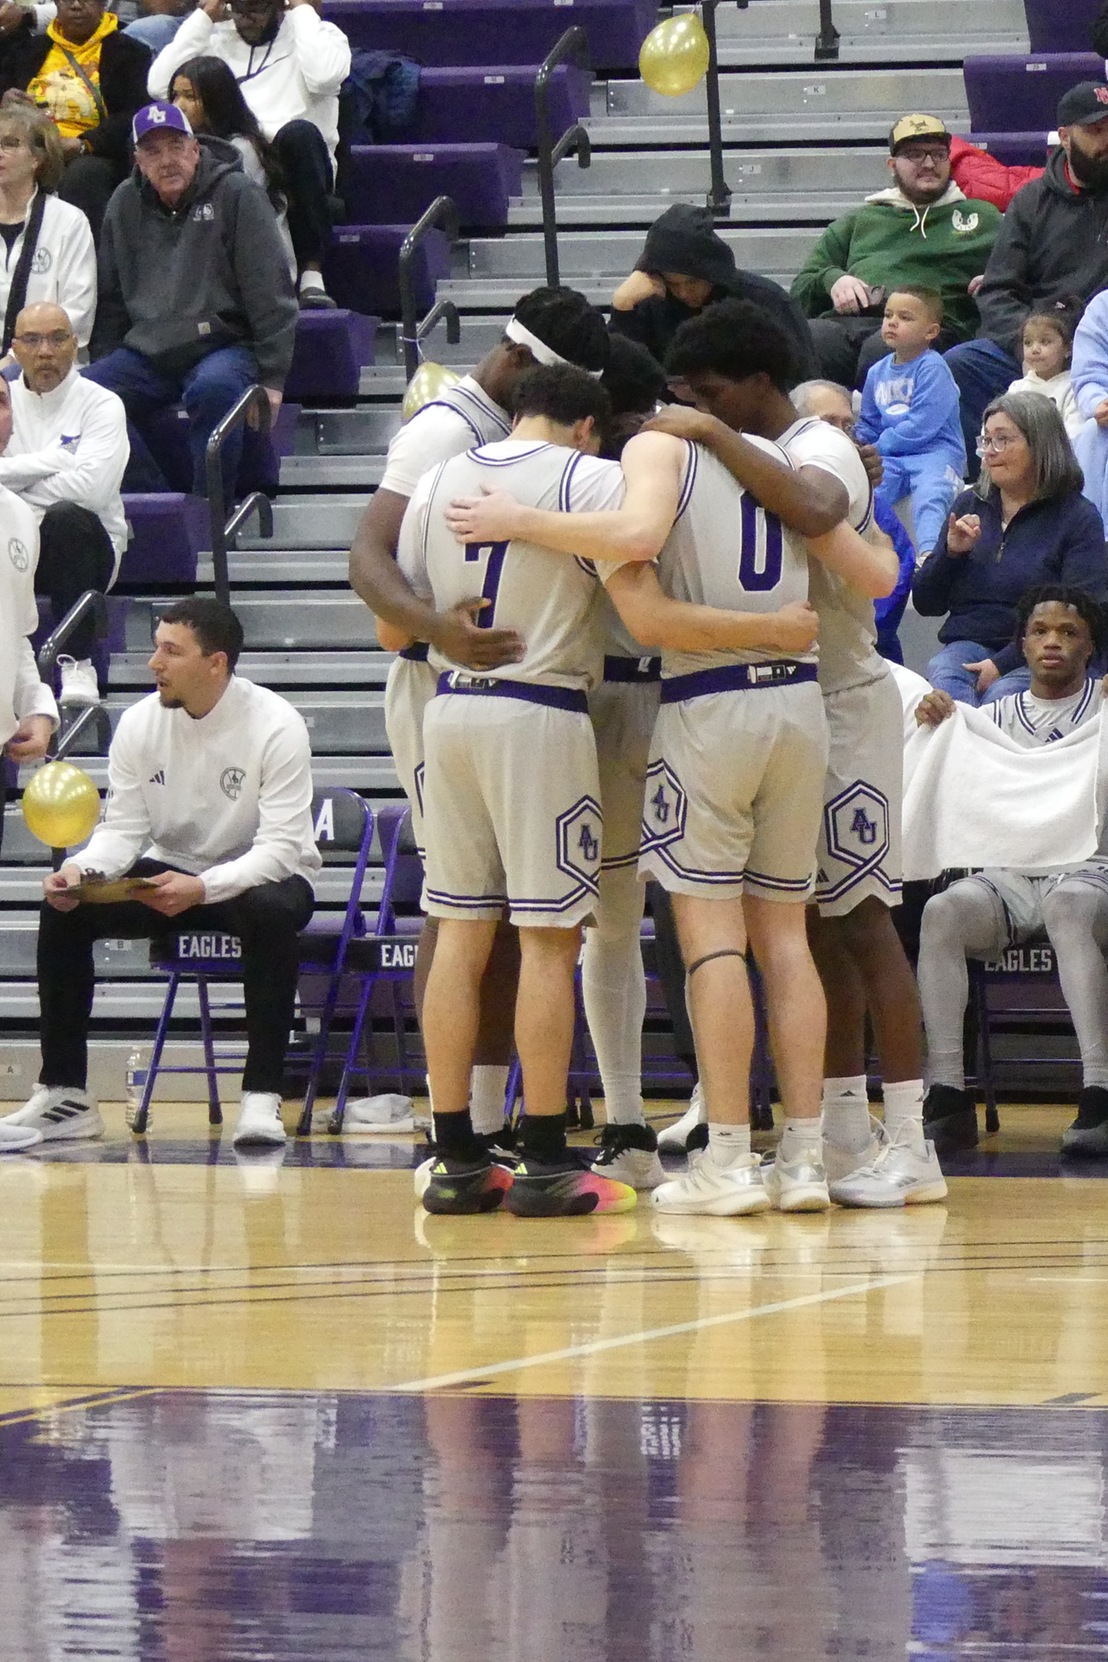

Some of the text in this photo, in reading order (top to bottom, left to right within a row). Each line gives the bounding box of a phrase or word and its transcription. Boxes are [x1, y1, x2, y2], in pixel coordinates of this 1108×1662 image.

[464, 540, 511, 630] 7
[577, 824, 599, 862] AU
[850, 807, 877, 844] AU
[178, 935, 243, 958] EAGLES
